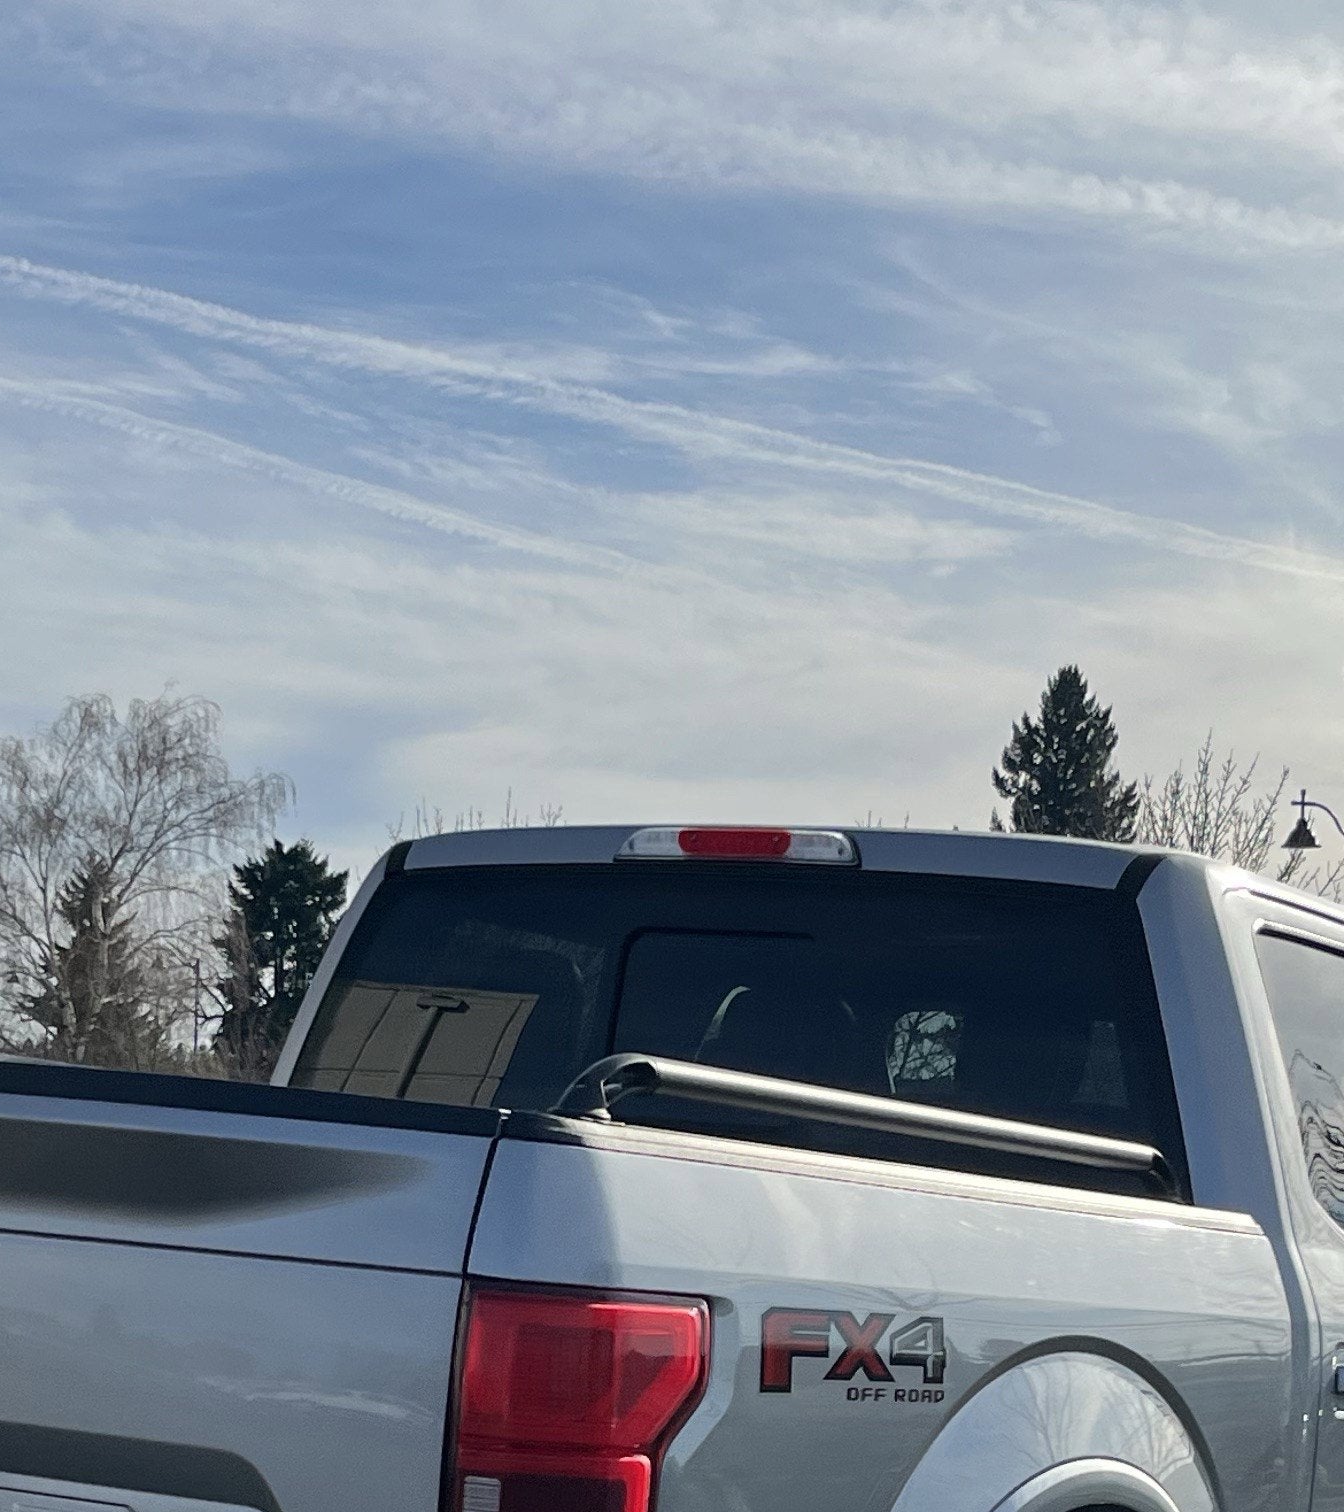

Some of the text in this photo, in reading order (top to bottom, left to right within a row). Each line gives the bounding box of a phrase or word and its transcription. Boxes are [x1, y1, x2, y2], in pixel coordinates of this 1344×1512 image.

[759, 1306, 947, 1393] FX4
[846, 1387, 945, 1404] OFF ROAD
